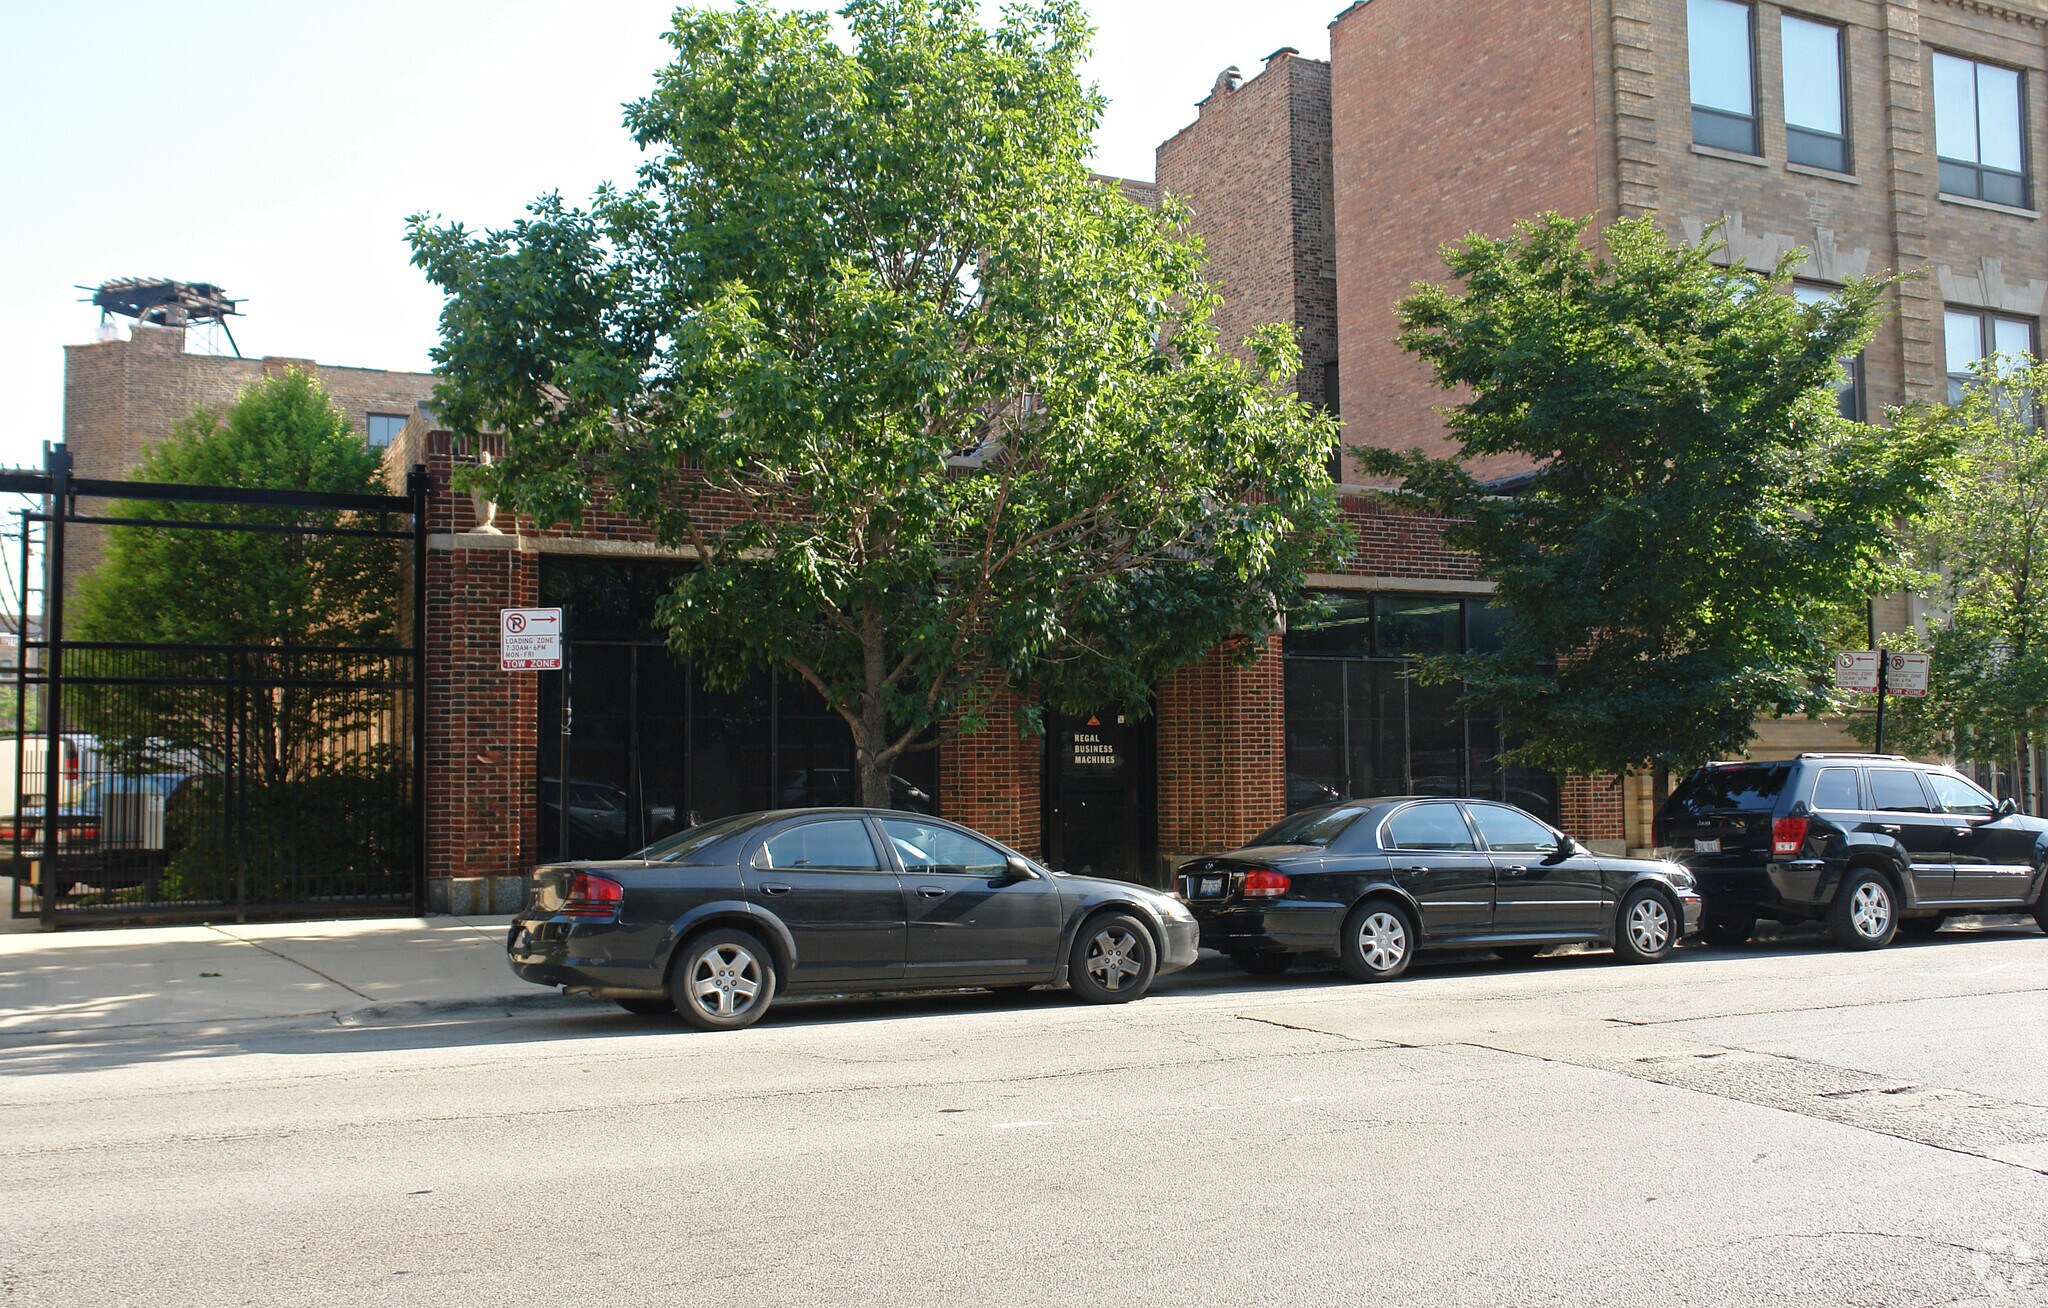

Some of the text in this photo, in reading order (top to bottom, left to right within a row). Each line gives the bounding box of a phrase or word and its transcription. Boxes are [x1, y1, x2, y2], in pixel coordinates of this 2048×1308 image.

[506, 660, 556, 668] TOW ZONE
[1074, 734, 1100, 743] REGAL
[1074, 744, 1113, 753] BUSINESS
[1074, 755, 1115, 764] MACHINES
